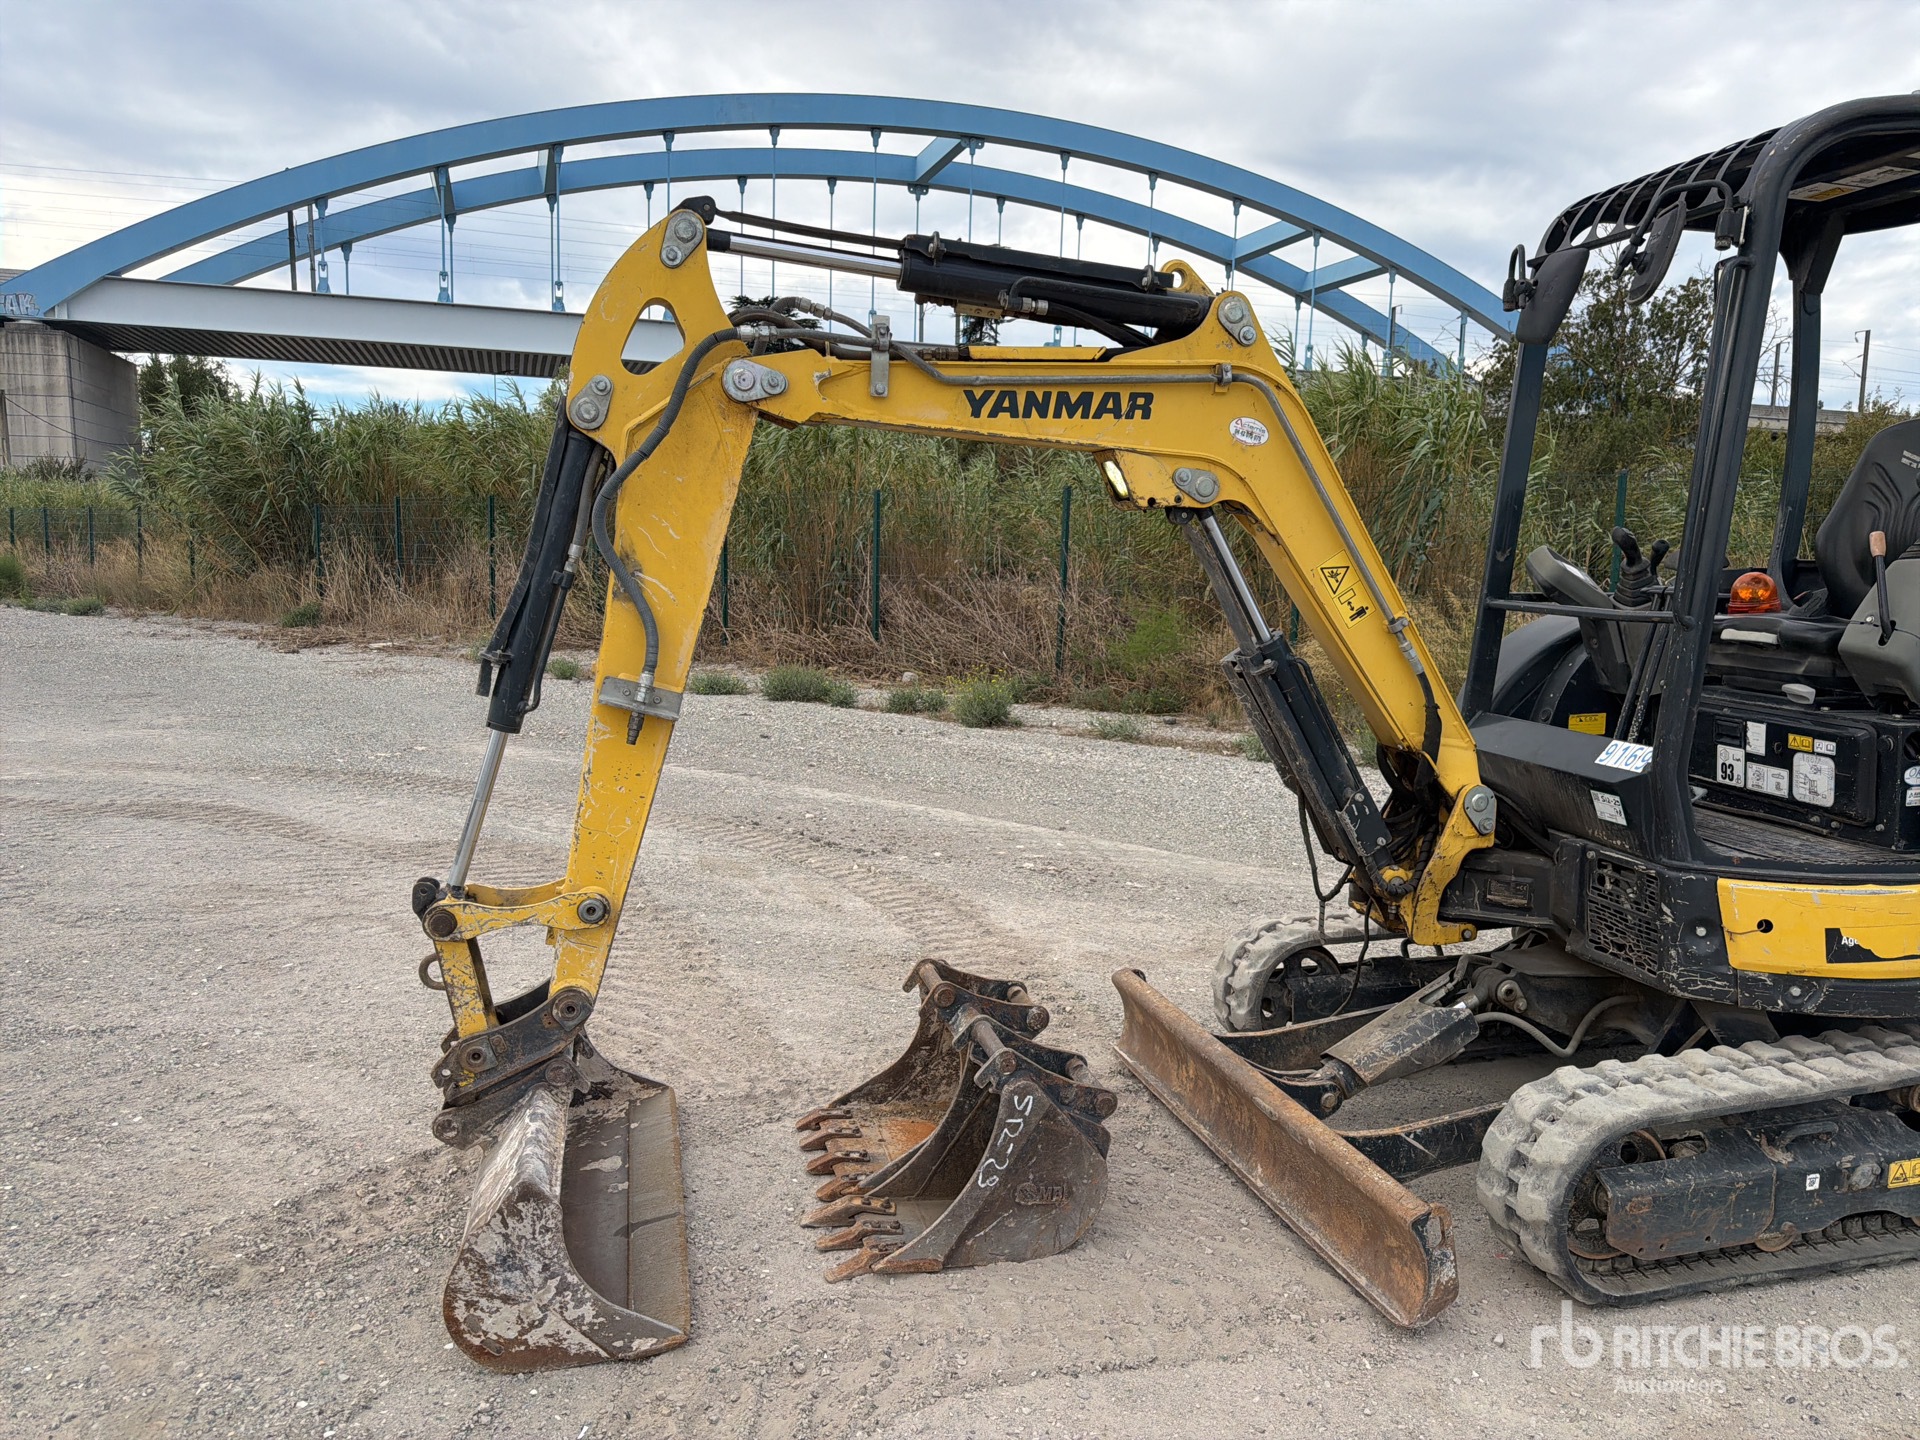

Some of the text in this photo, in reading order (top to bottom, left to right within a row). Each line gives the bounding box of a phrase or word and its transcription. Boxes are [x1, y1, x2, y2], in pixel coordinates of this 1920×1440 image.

[963, 389, 1154, 420] YANMAR
[1599, 743, 1654, 770] 9169
[1720, 762, 1735, 782] 93
